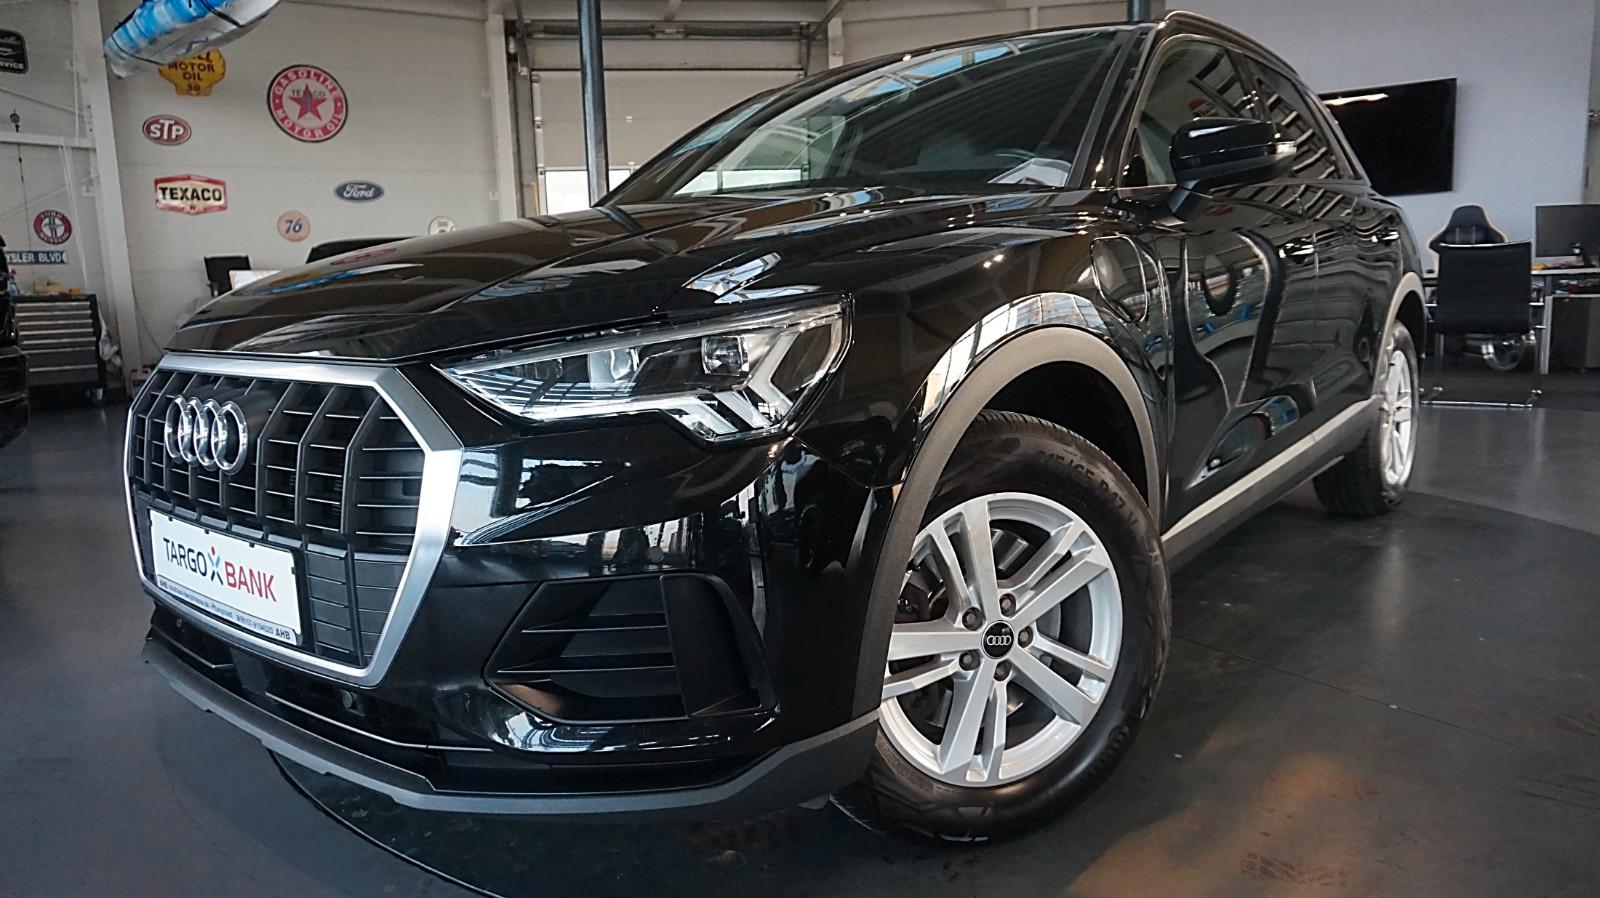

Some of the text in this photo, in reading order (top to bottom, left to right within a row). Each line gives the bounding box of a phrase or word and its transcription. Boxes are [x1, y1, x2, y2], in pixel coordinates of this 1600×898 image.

[168, 62, 215, 73] MOTOR
[183, 71, 203, 81] OIL
[275, 69, 341, 97] GASOLINE
[150, 119, 184, 140] STP
[276, 109, 342, 138] MOTOR OIL
[159, 187, 222, 202] TEXACO
[342, 183, 375, 199] Ford
[284, 219, 303, 235] 76
[163, 537, 208, 577] TARGO
[224, 561, 277, 602] BANK
[275, 628, 291, 640] AHB
